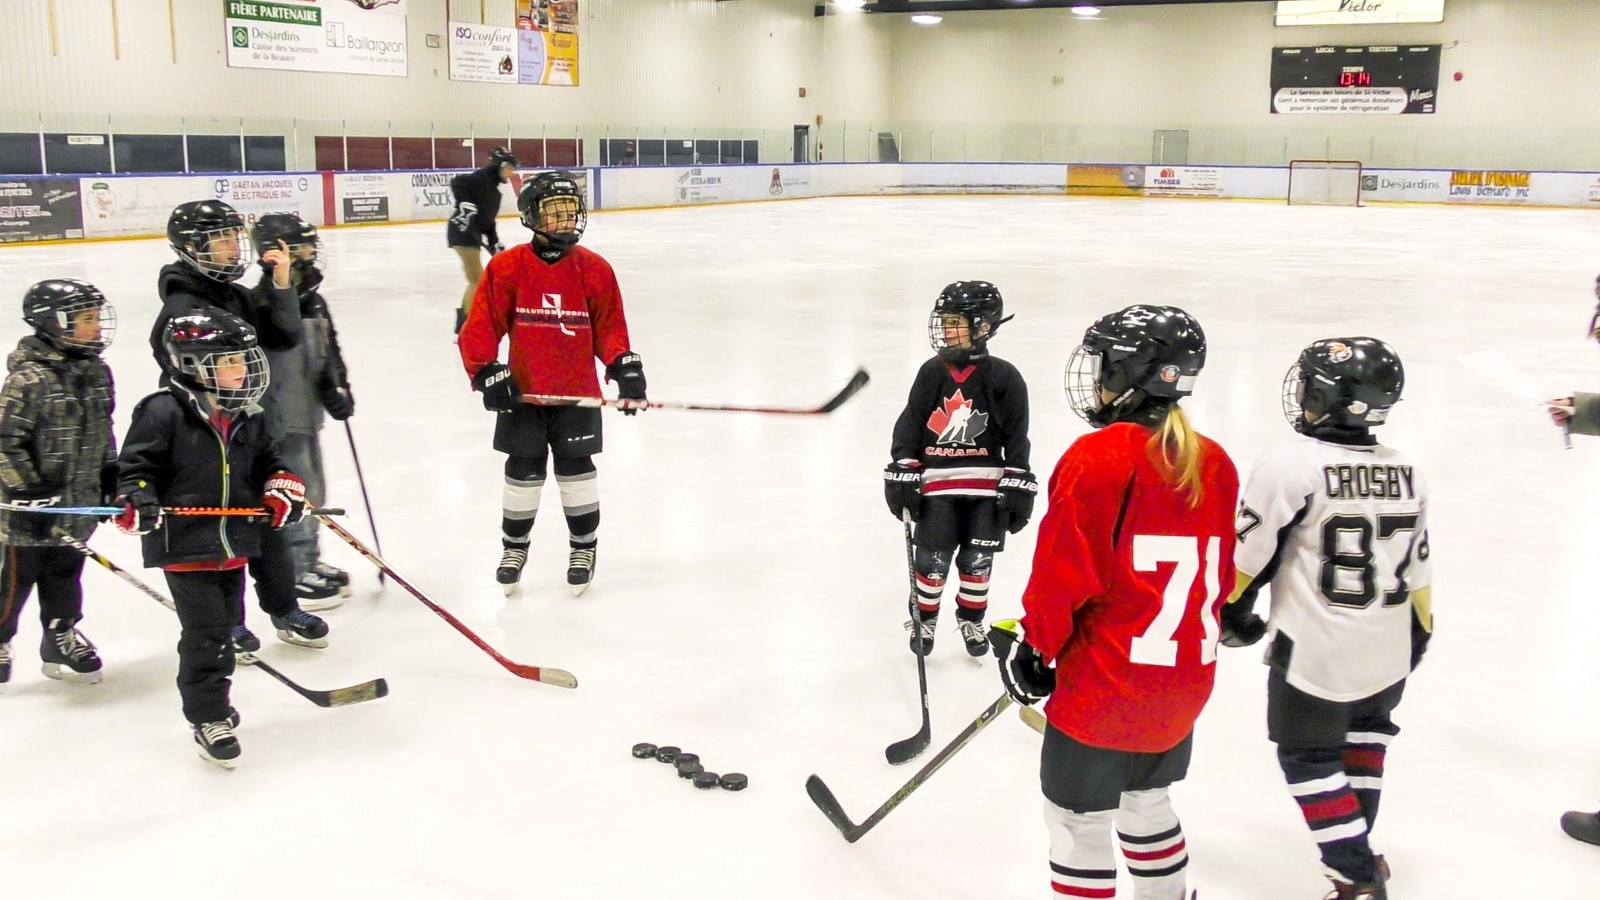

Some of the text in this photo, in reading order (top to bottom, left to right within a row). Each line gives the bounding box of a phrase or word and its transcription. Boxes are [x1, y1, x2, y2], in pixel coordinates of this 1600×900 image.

[230, 2, 318, 22] FIÈRE PARTENAIRE
[252, 27, 301, 42] Desjardins
[456, 27, 472, 39] ISO
[472, 28, 512, 46] confort
[348, 35, 404, 55] Baillargeon
[1340, 72, 1370, 85] 13:14
[261, 180, 293, 188] JACQUES
[1381, 178, 1440, 190] Desjardins
[516, 307, 558, 315] SOLUTION
[925, 446, 989, 457] CANADA
[1323, 464, 1415, 500] CROSBY
[970, 538, 1000, 547] CCM
[1321, 512, 1420, 609] 87
[1129, 534, 1221, 667] 71
